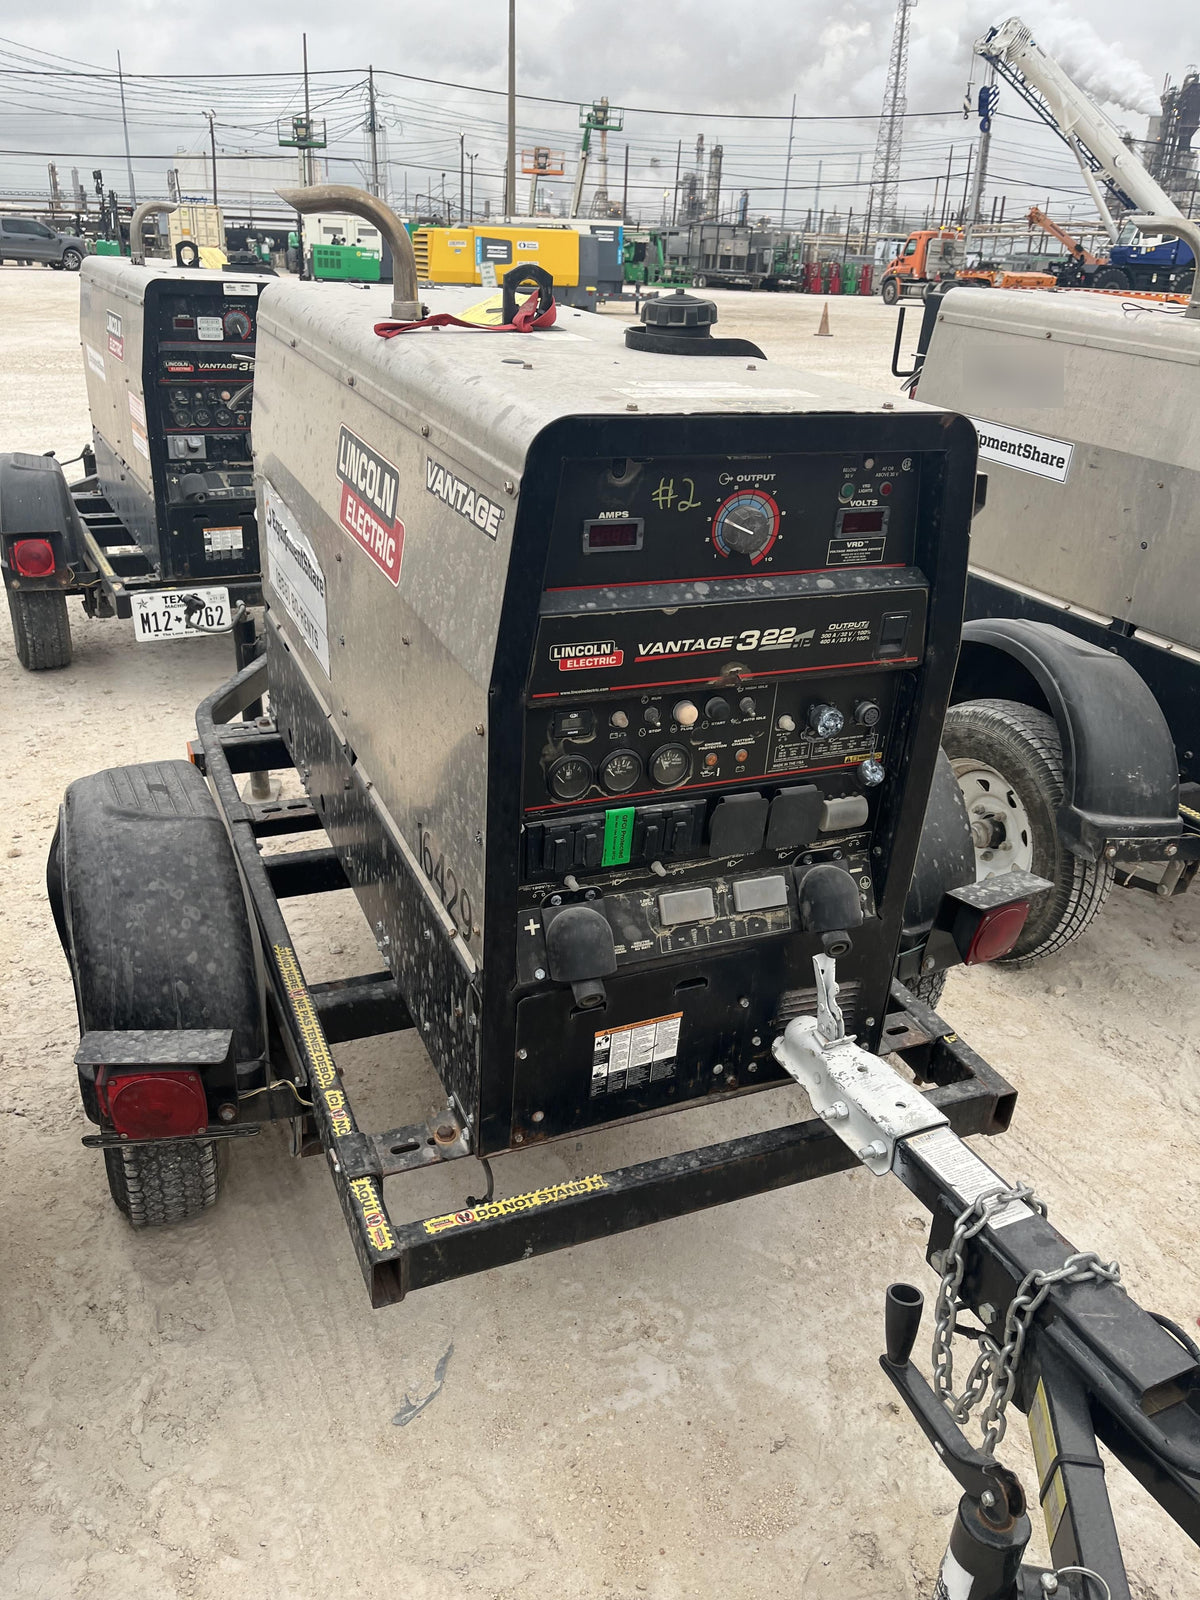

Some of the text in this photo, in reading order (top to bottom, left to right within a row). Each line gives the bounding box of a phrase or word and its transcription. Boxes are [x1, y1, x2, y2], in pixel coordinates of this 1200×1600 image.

[238, 362, 255, 371] 32
[976, 430, 1065, 469] ipmentShare
[339, 435, 396, 519] LINCOLN
[736, 473, 777, 482] OUTPUT
[427, 459, 501, 538] VANTAGE
[651, 477, 702, 512] #2
[850, 499, 879, 507] VOLTS
[598, 510, 630, 520] AMPS
[345, 494, 396, 569] ELECTRIC
[162, 593, 198, 605] TEX
[140, 605, 225, 634] M12 262
[828, 621, 867, 630] OUTPUT
[553, 643, 611, 658] LINCOLN
[637, 635, 735, 656] VANTAGE
[736, 626, 797, 652] 322
[566, 655, 617, 668] ELECTRIC
[417, 822, 472, 942] 16429
[286, 969, 299, 989] HERE
[296, 998, 332, 1087] NE PAS TENEZ DEBOU
[328, 1093, 340, 1107] ICI
[476, 1178, 602, 1218] DO NOT STAND H
